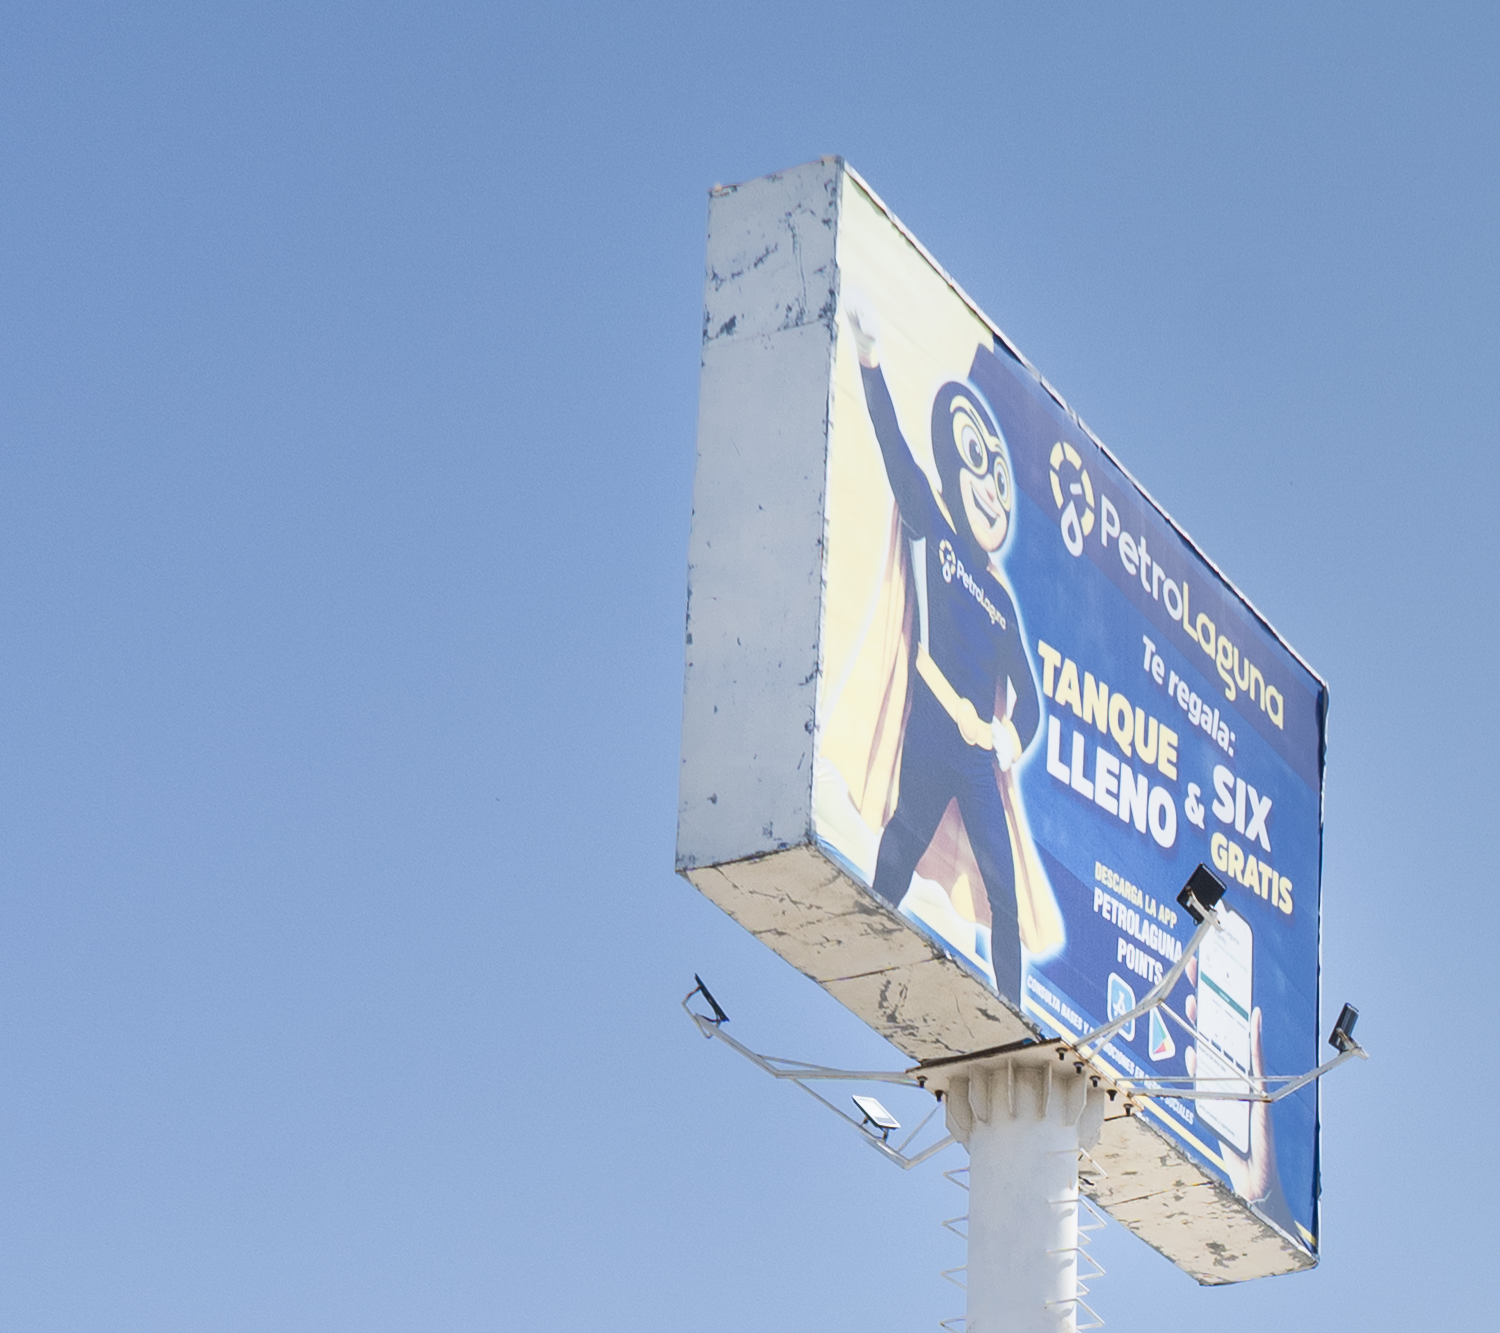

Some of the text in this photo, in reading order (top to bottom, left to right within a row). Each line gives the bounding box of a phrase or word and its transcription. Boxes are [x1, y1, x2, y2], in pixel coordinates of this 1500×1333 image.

[1100, 493, 1284, 730] PetroLaguna
[1037, 639, 1179, 782] TANQUE
[1143, 635, 1236, 757] Te regala:
[1046, 714, 1177, 848] LLENO
[1212, 764, 1273, 852] SIX
[1095, 861, 1178, 930] DESCARGA LA APP
[1211, 831, 1293, 915] GRATIS
[1093, 886, 1183, 963] PETROLAGUNA
[1117, 937, 1164, 985] POINTS
